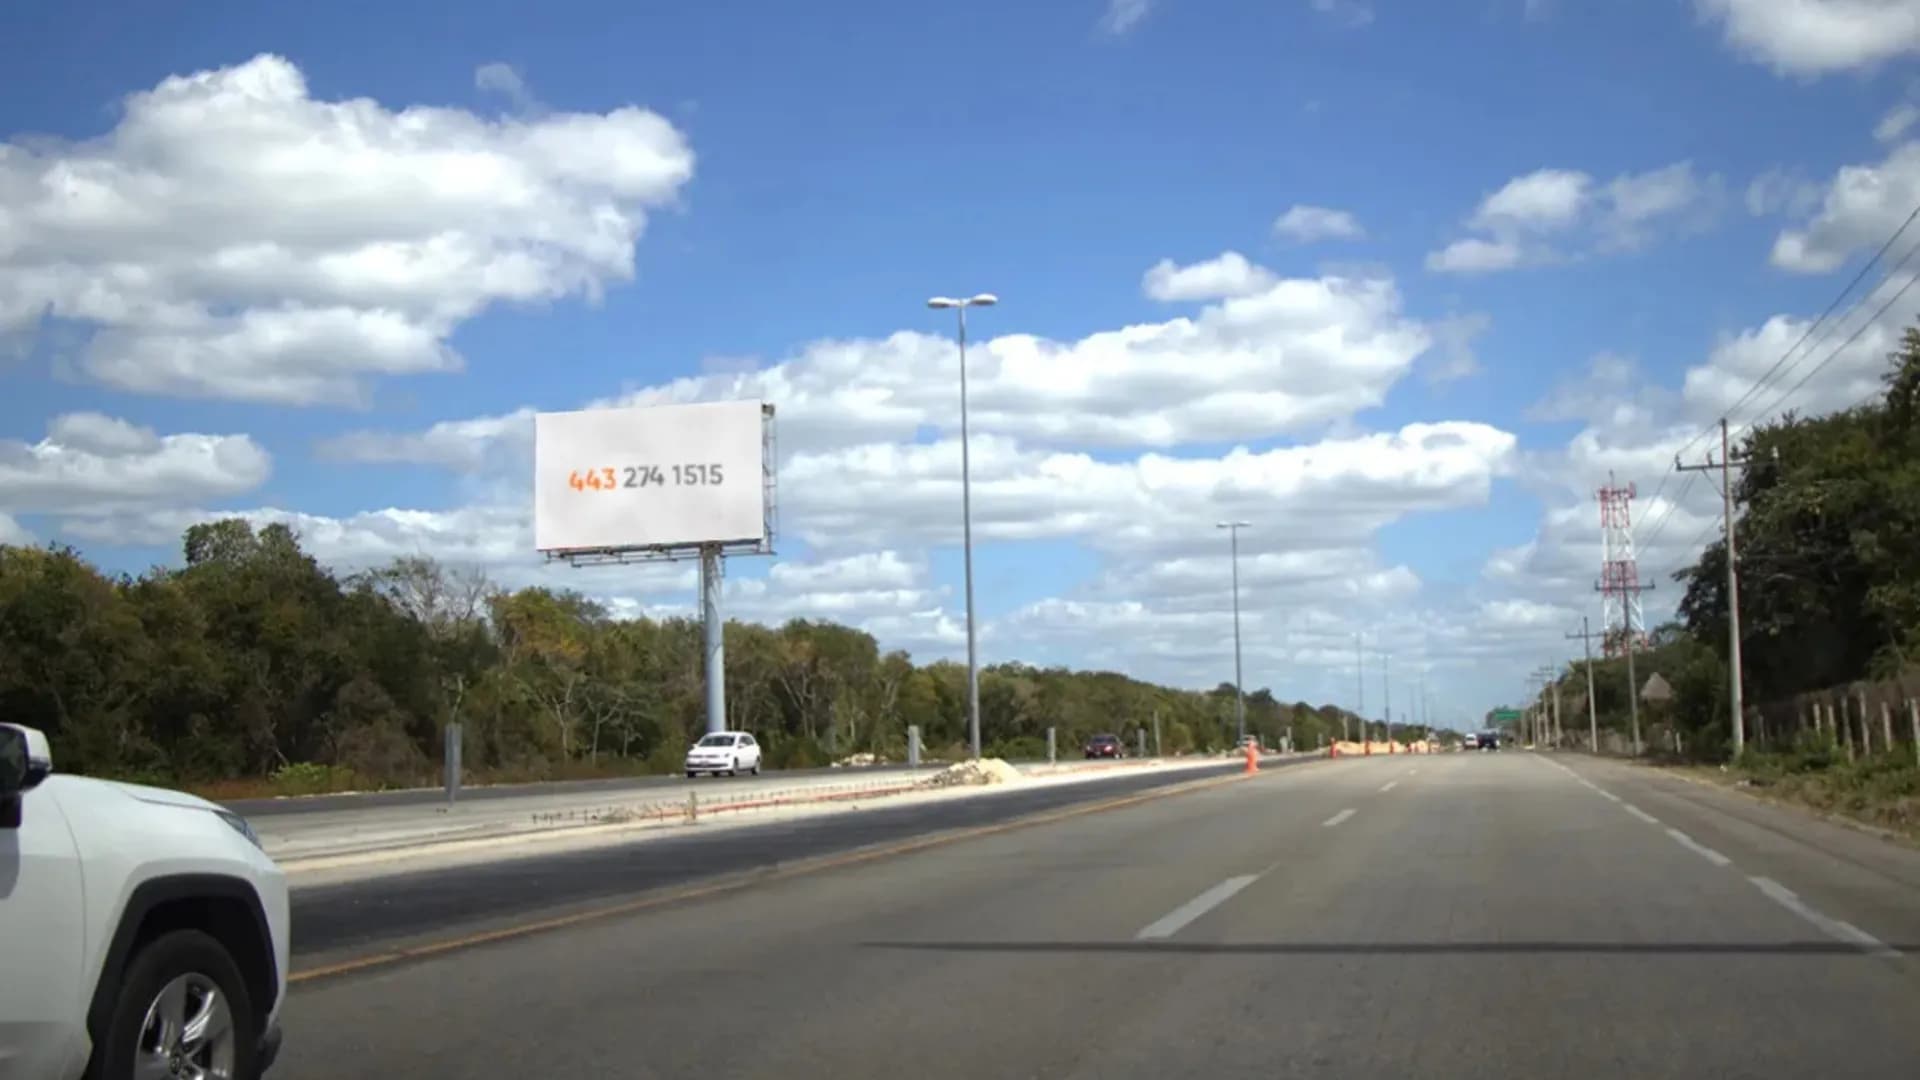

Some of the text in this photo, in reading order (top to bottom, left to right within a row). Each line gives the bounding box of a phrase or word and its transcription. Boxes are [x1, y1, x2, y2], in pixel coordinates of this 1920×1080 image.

[569, 464, 724, 491] 443 274 1515
